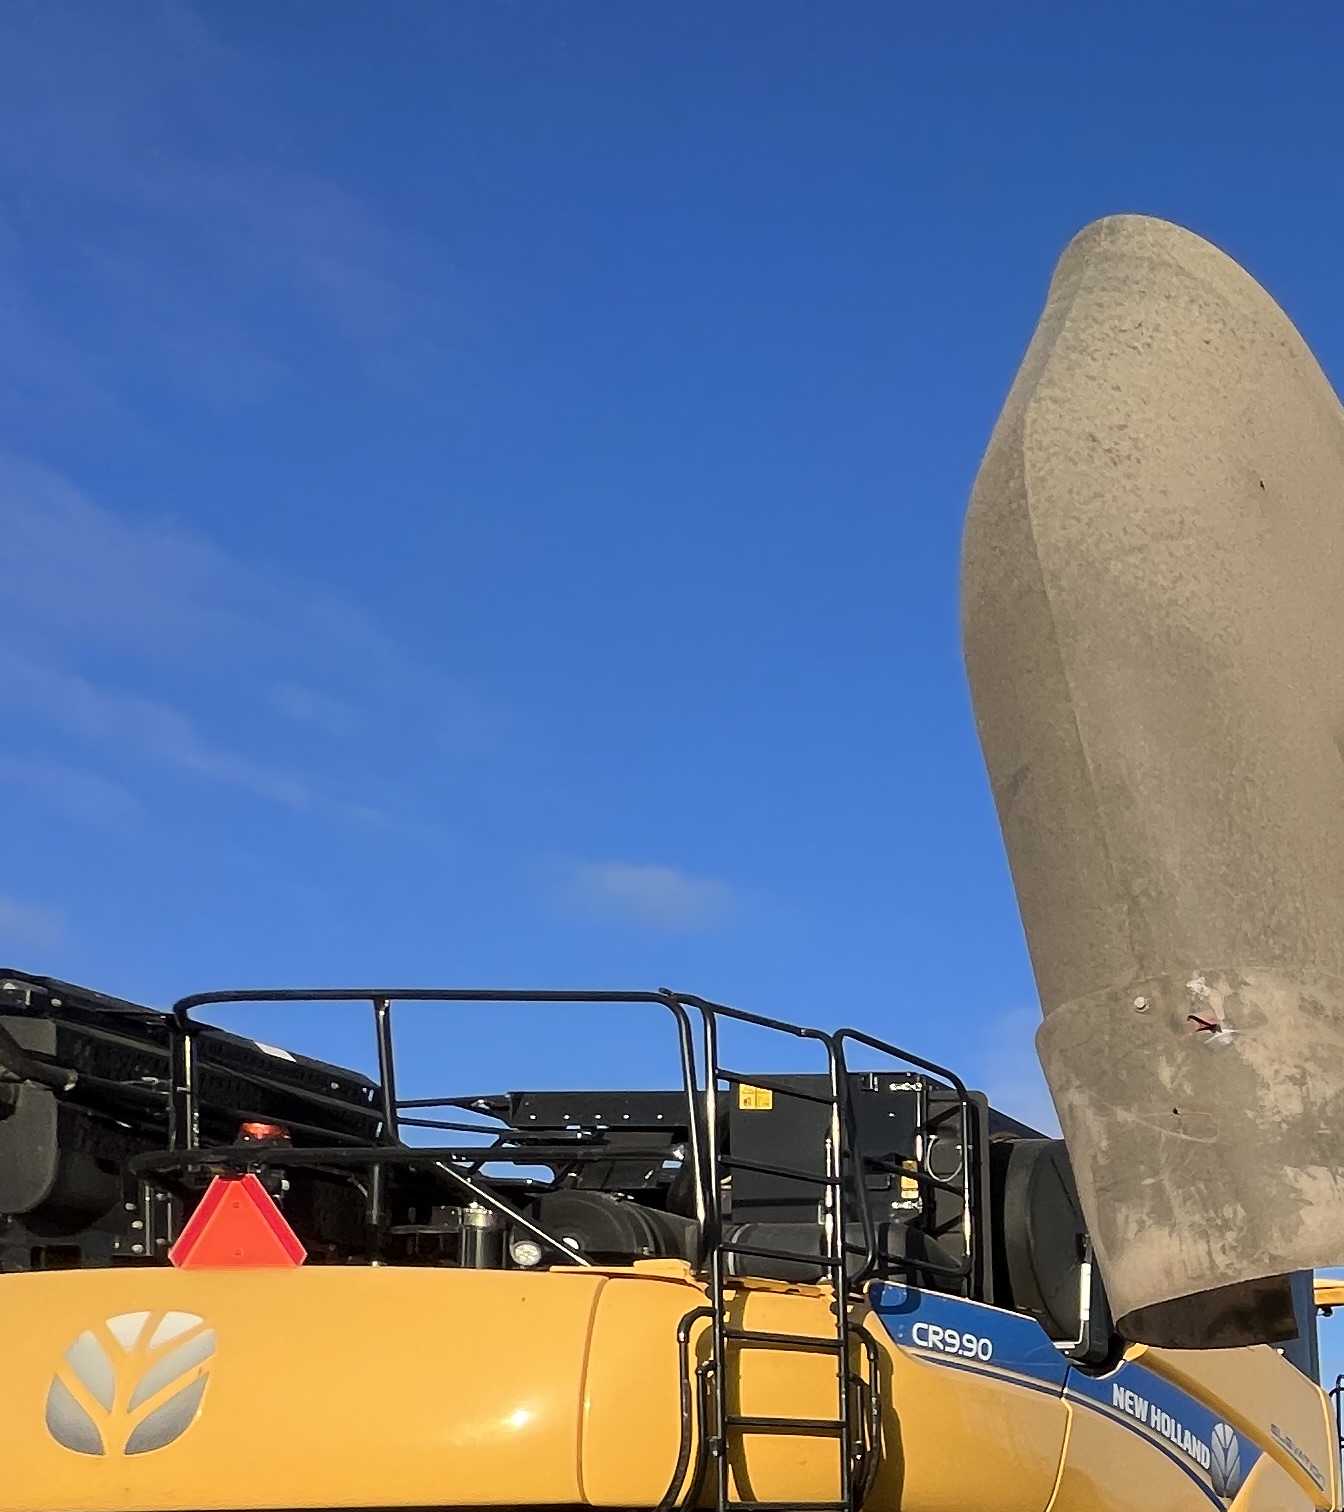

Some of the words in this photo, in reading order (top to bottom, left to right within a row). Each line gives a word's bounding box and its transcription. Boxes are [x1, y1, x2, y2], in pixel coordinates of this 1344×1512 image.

[912, 1322, 993, 1362] CR9.90
[1112, 1382, 1149, 1422] NEW
[1150, 1404, 1211, 1470] HOLLAND
